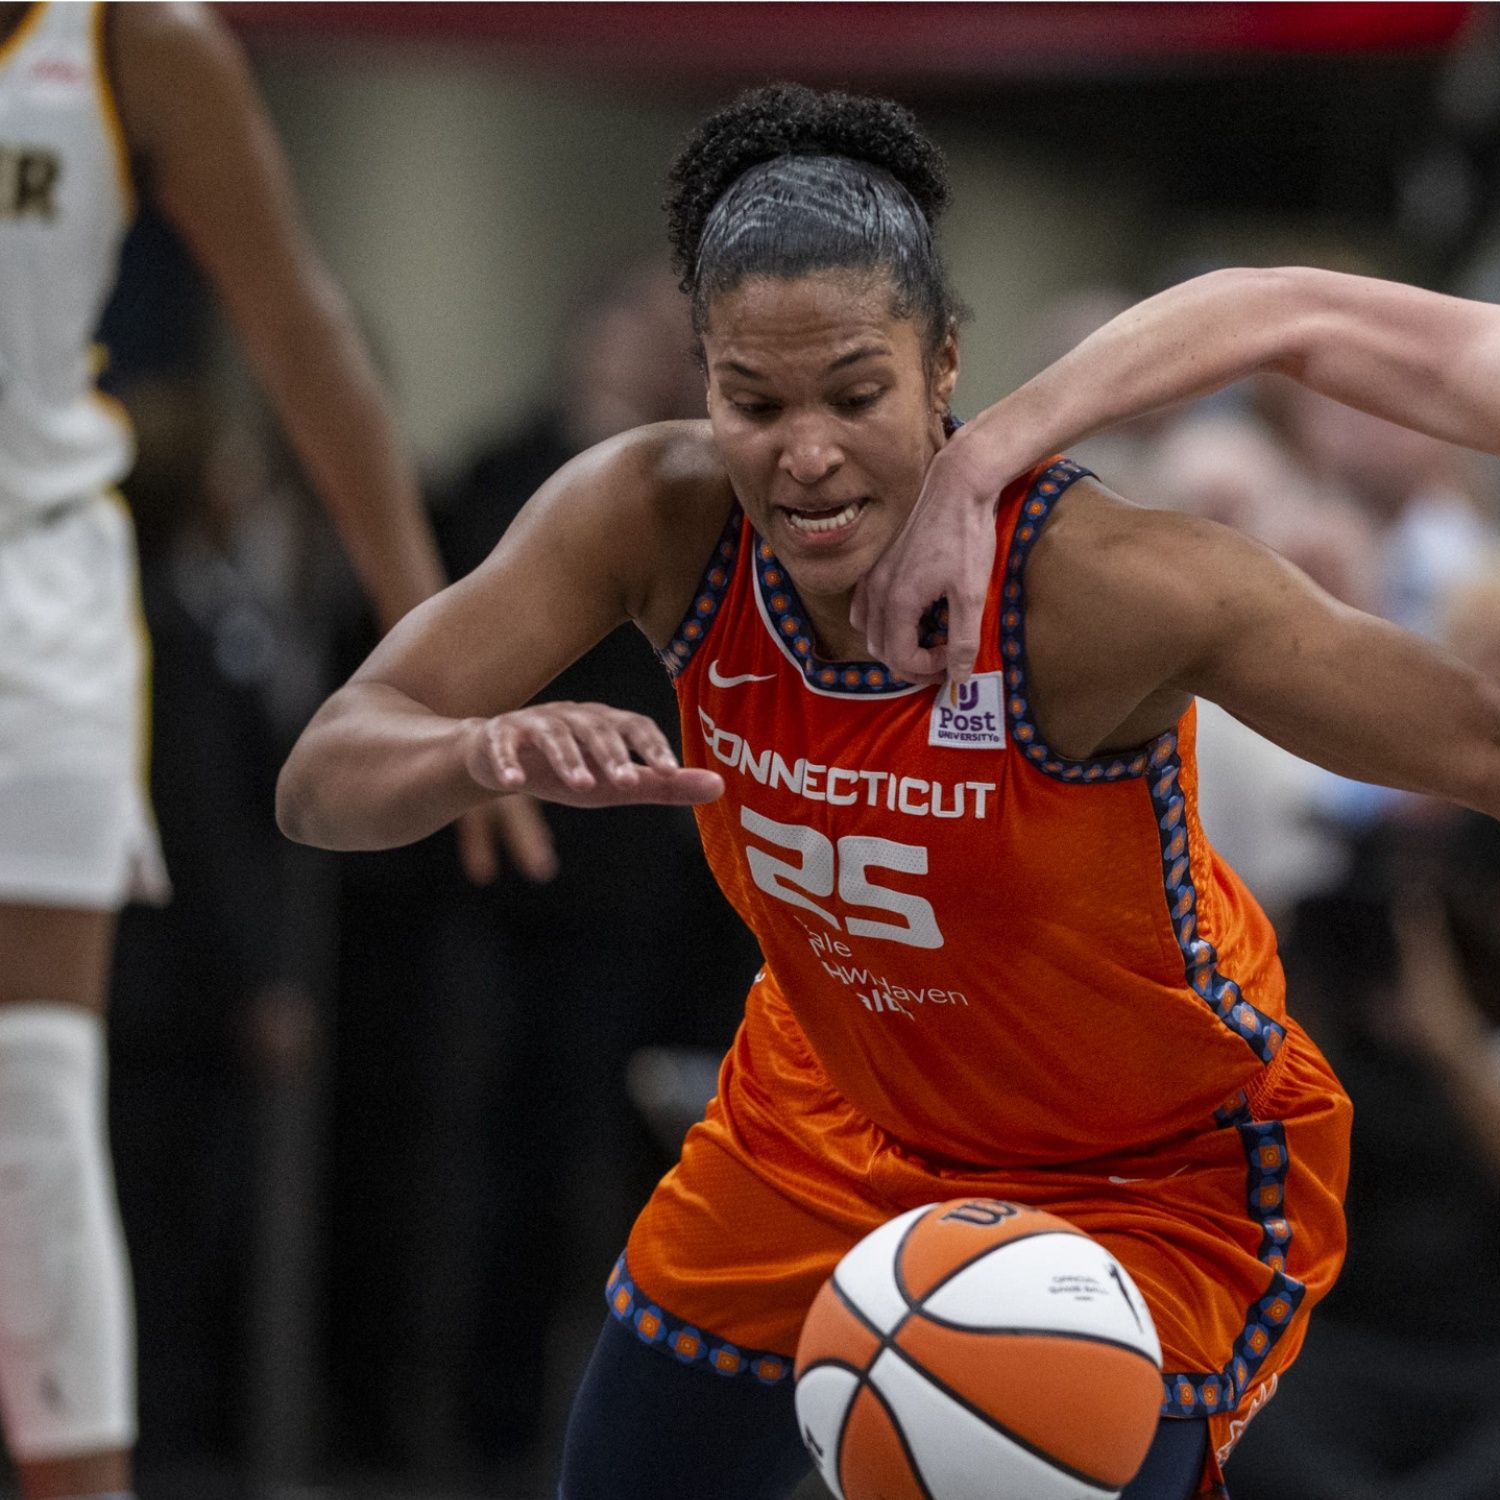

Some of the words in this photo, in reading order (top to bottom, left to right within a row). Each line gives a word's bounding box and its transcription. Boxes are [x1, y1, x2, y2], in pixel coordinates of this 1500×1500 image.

[698, 705, 996, 819] CONNECTICUT
[939, 706, 996, 731] Post
[741, 804, 945, 949] 25
